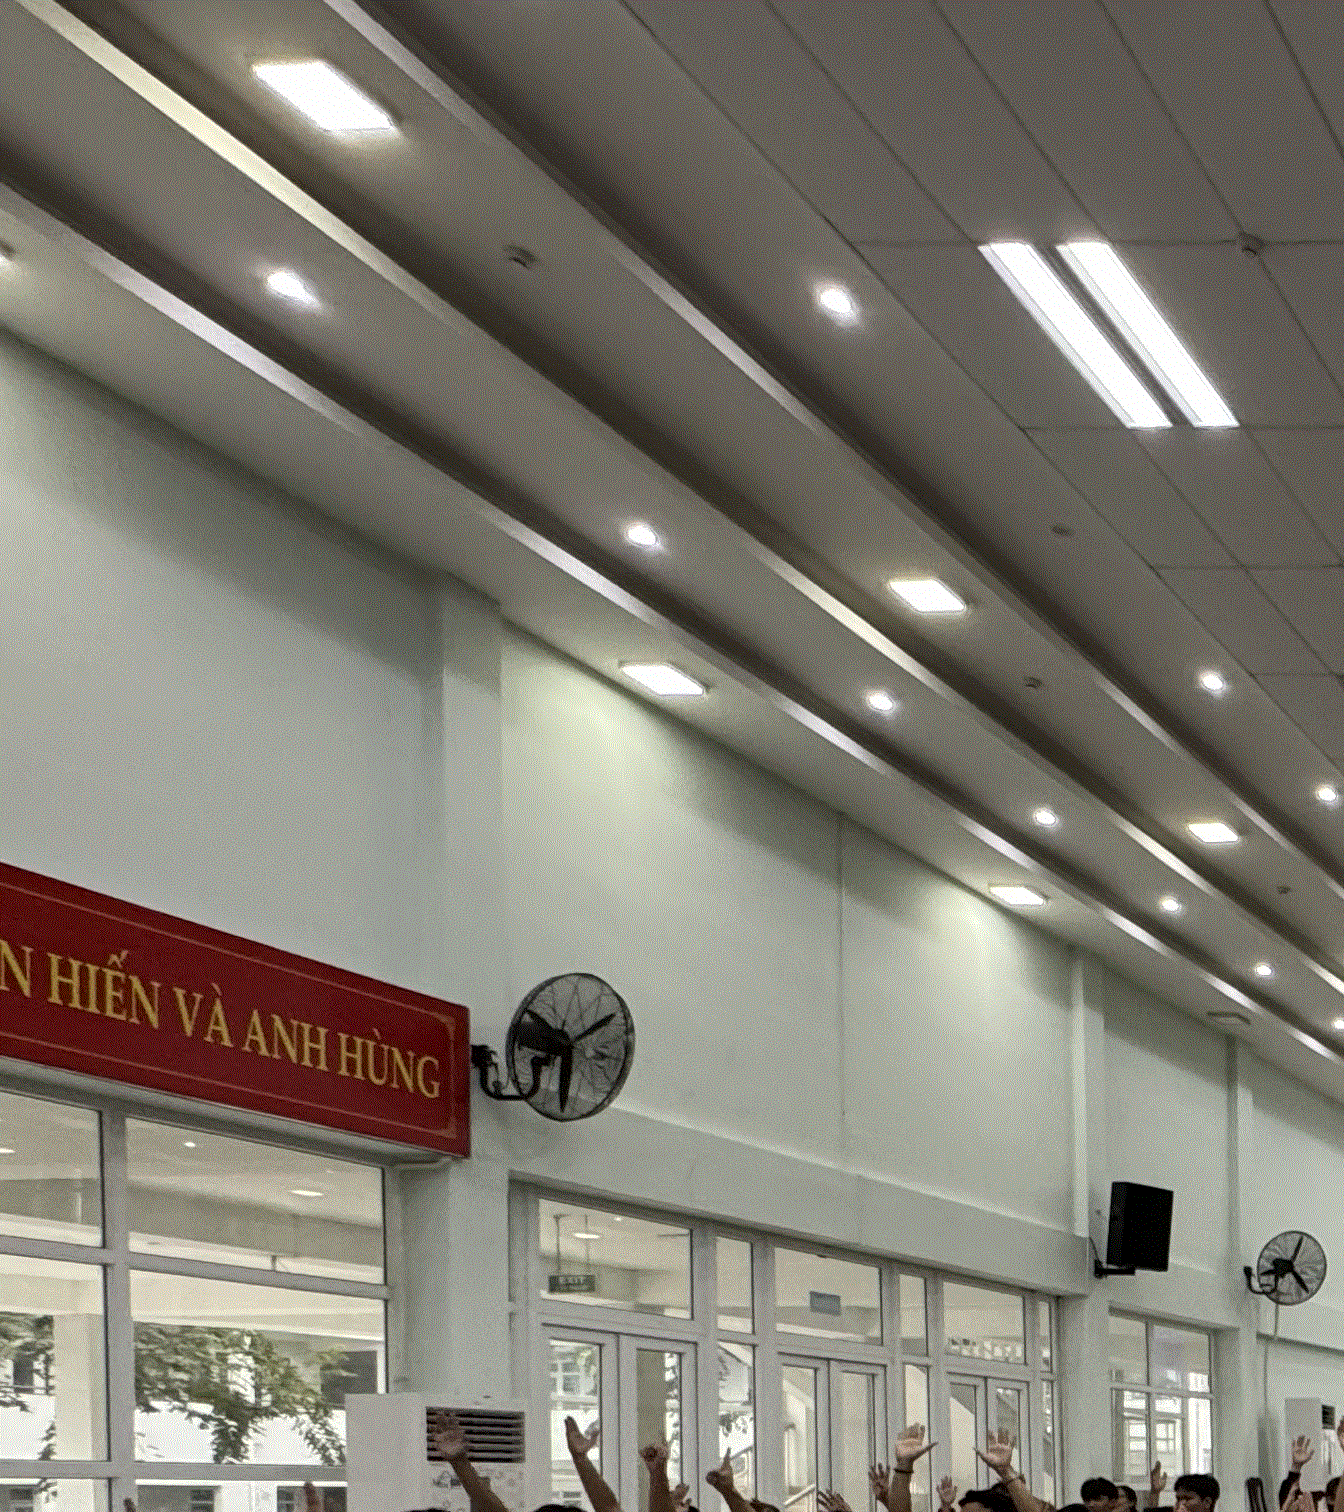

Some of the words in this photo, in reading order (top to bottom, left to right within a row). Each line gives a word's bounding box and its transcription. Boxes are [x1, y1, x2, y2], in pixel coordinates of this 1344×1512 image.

[47, 950, 161, 1030] HIẾN
[172, 982, 234, 1049] VÀ
[242, 1009, 330, 1072] ANH
[338, 1028, 441, 1099] HÙNG
